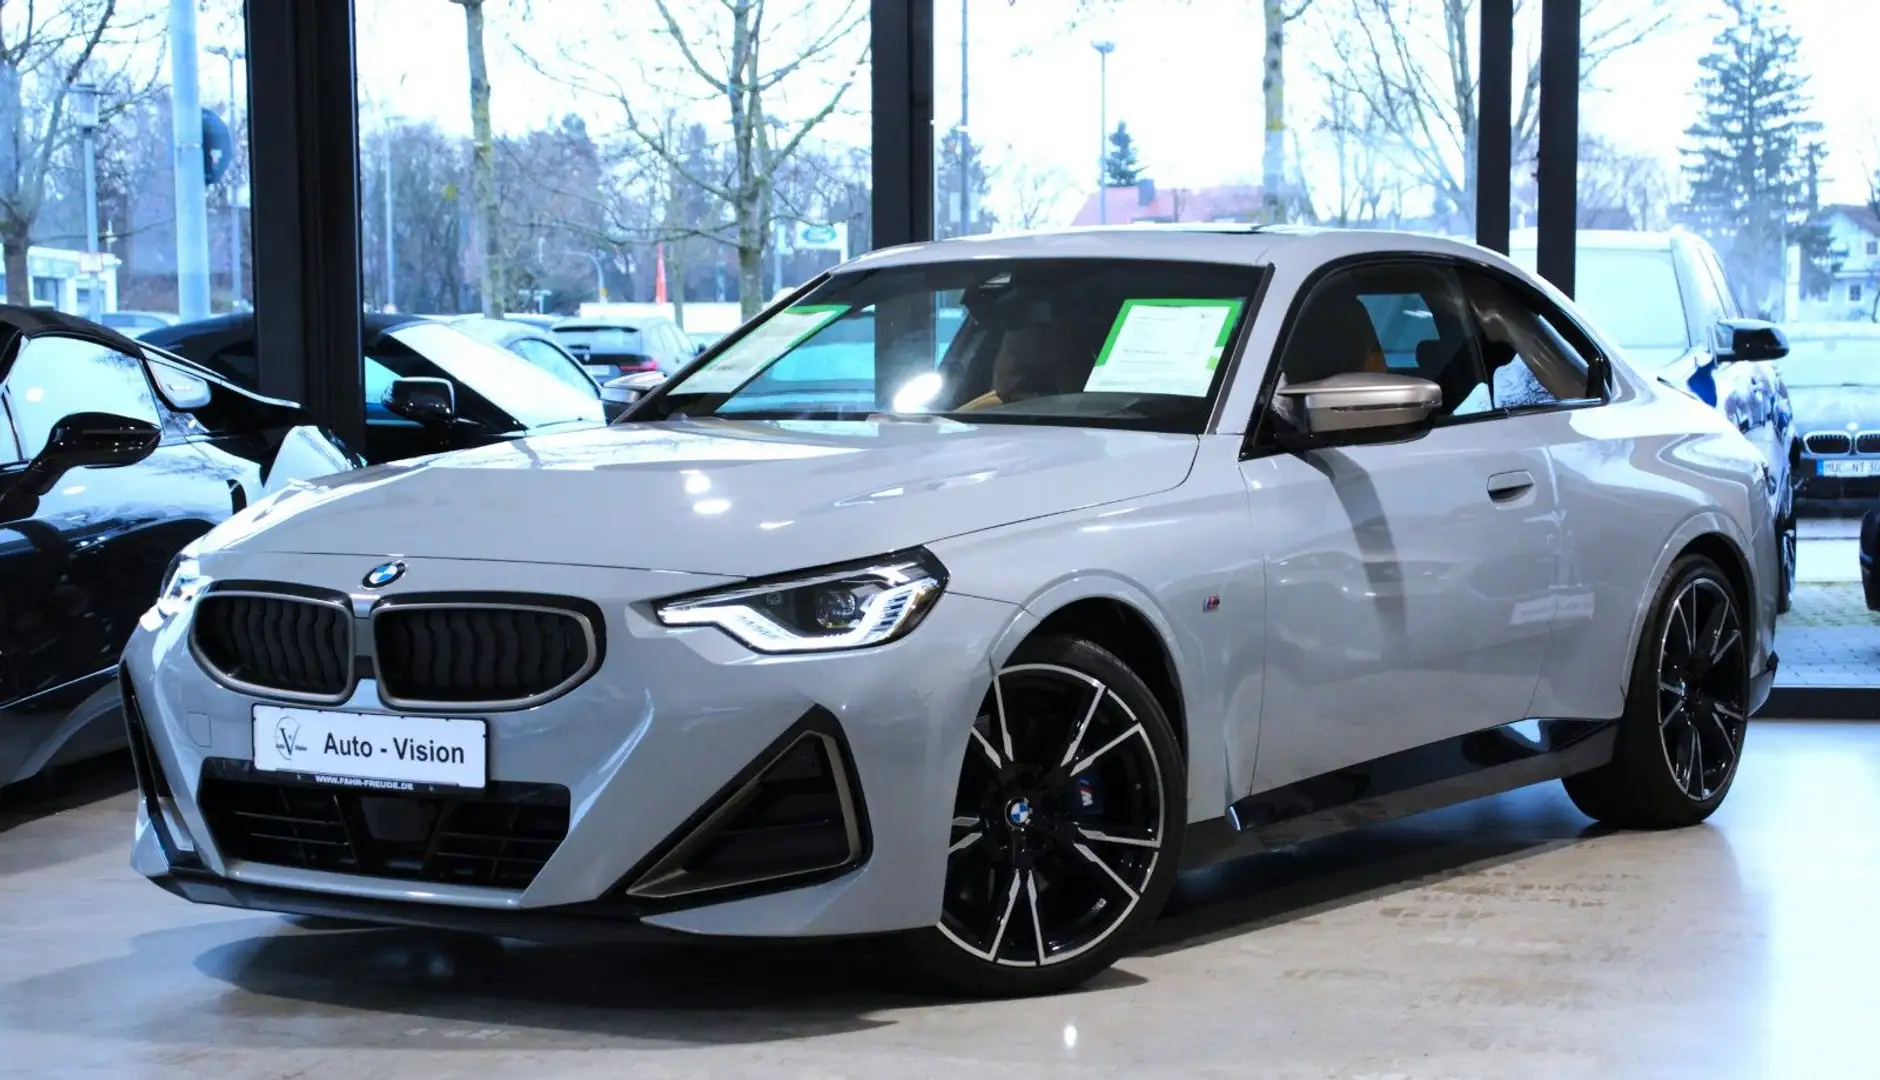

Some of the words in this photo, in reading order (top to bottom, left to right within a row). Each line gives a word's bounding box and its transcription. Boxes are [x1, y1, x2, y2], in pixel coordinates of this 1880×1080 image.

[323, 731, 373, 758] Auto
[392, 736, 464, 764] Vision
[315, 775, 414, 790] WWW.FAHR-FREUDE.DE
